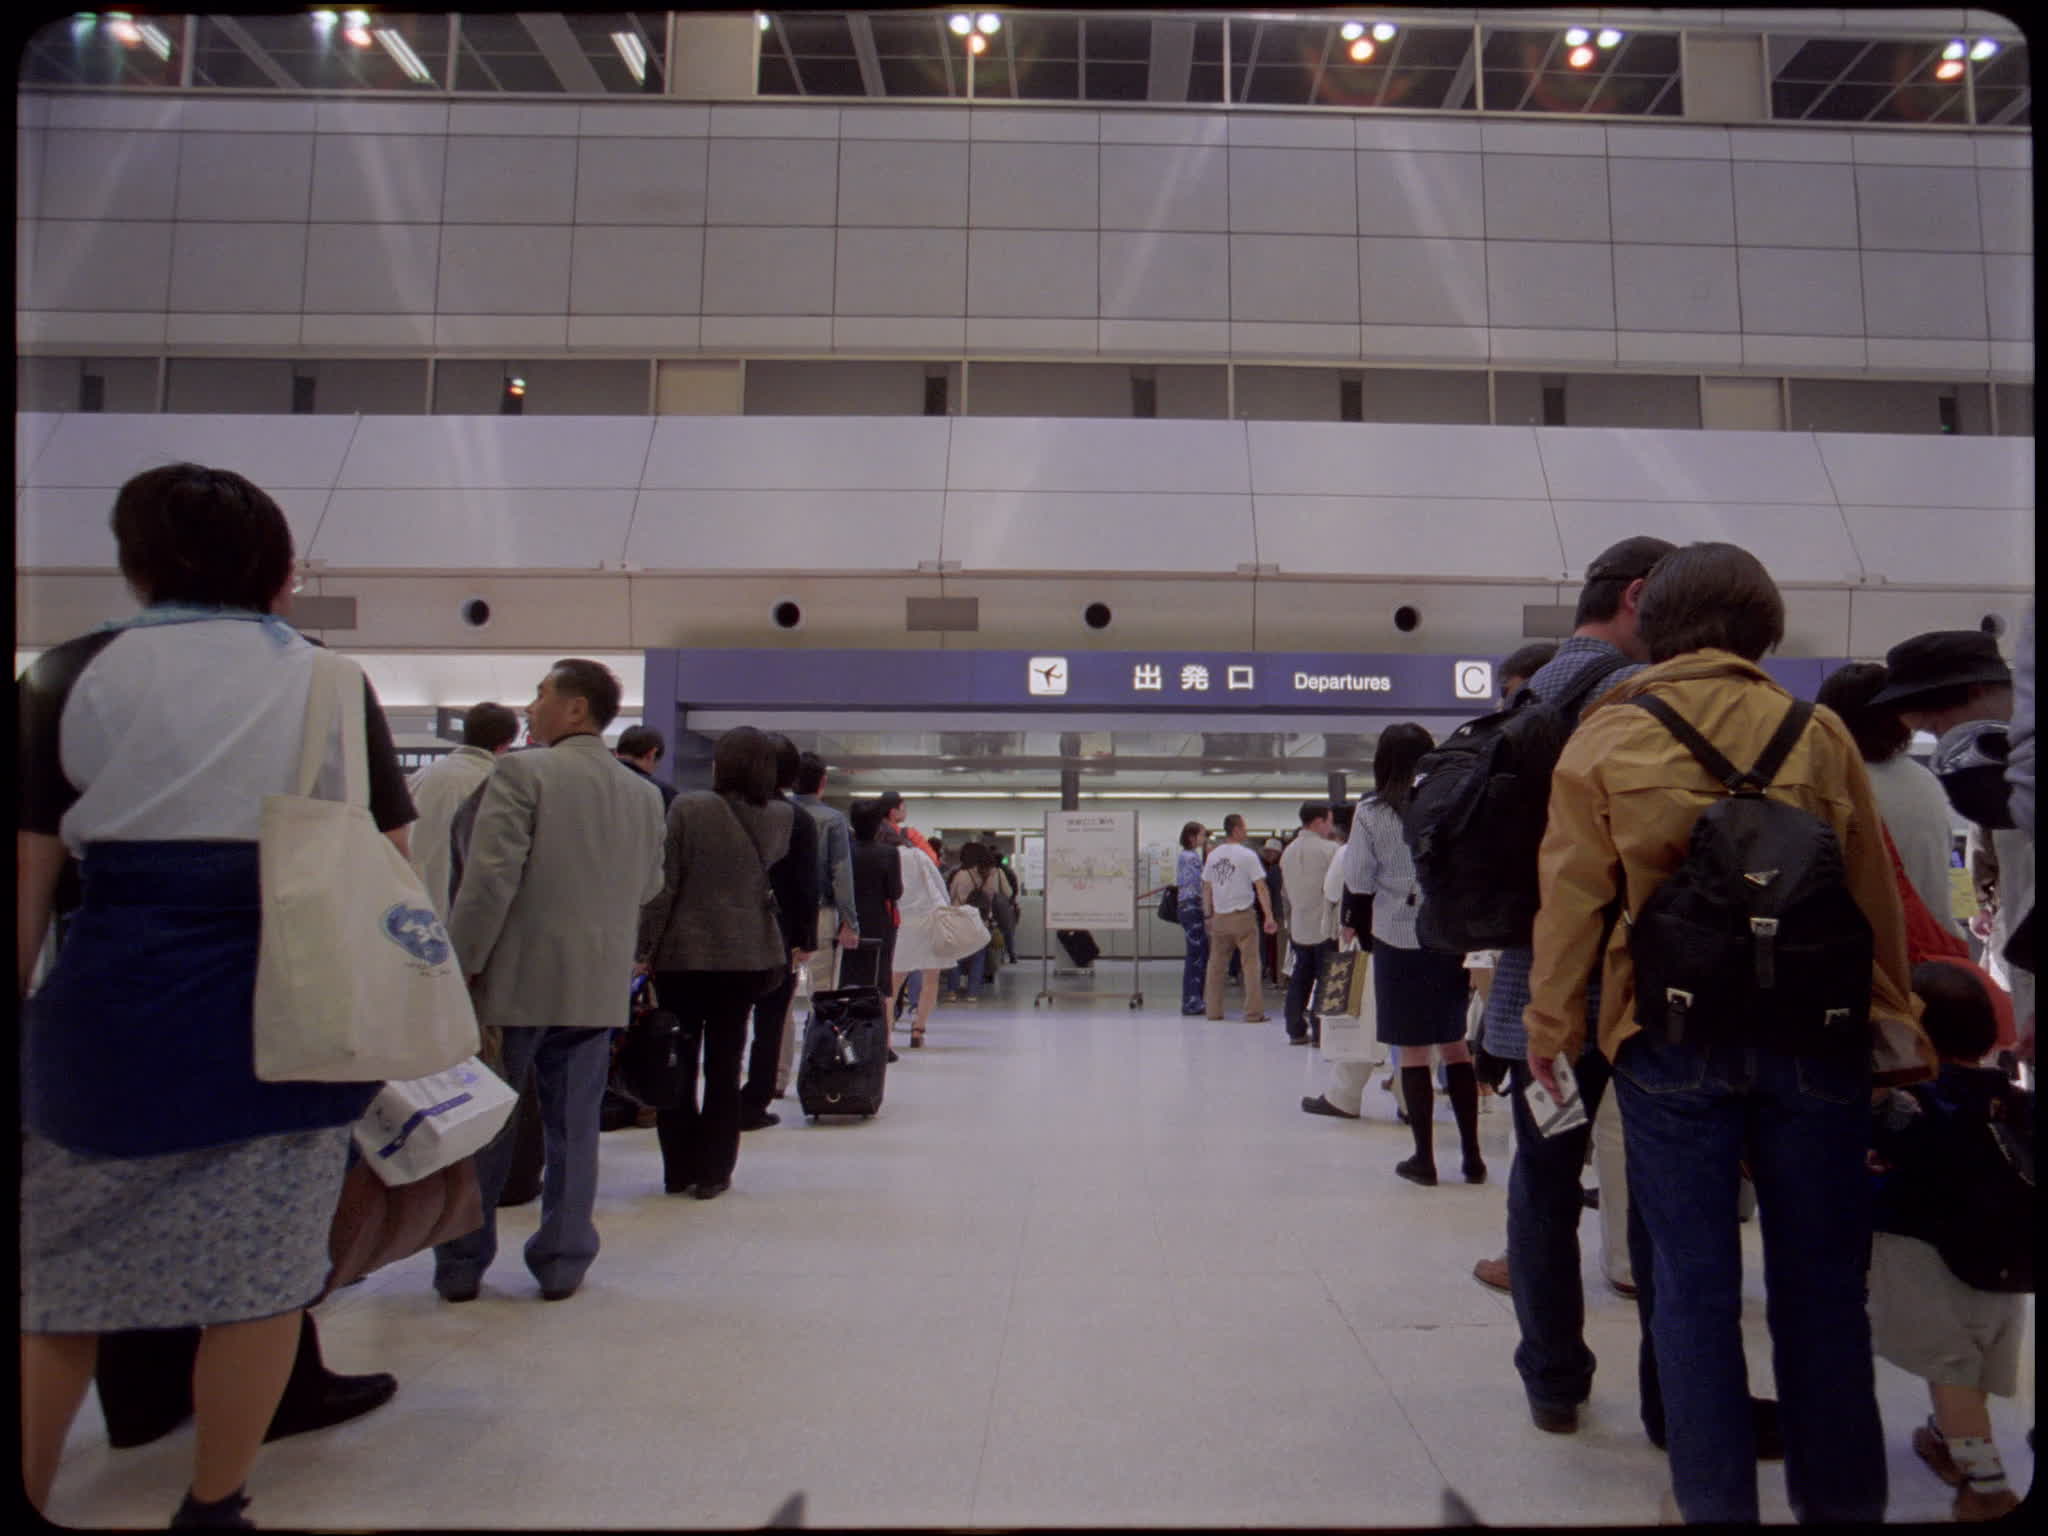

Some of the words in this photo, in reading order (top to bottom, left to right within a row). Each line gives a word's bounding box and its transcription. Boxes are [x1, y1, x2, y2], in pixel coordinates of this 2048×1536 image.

[1134, 663, 1254, 690] 出発口
[1294, 673, 1391, 693] Departures
[1461, 665, 1486, 695] C
